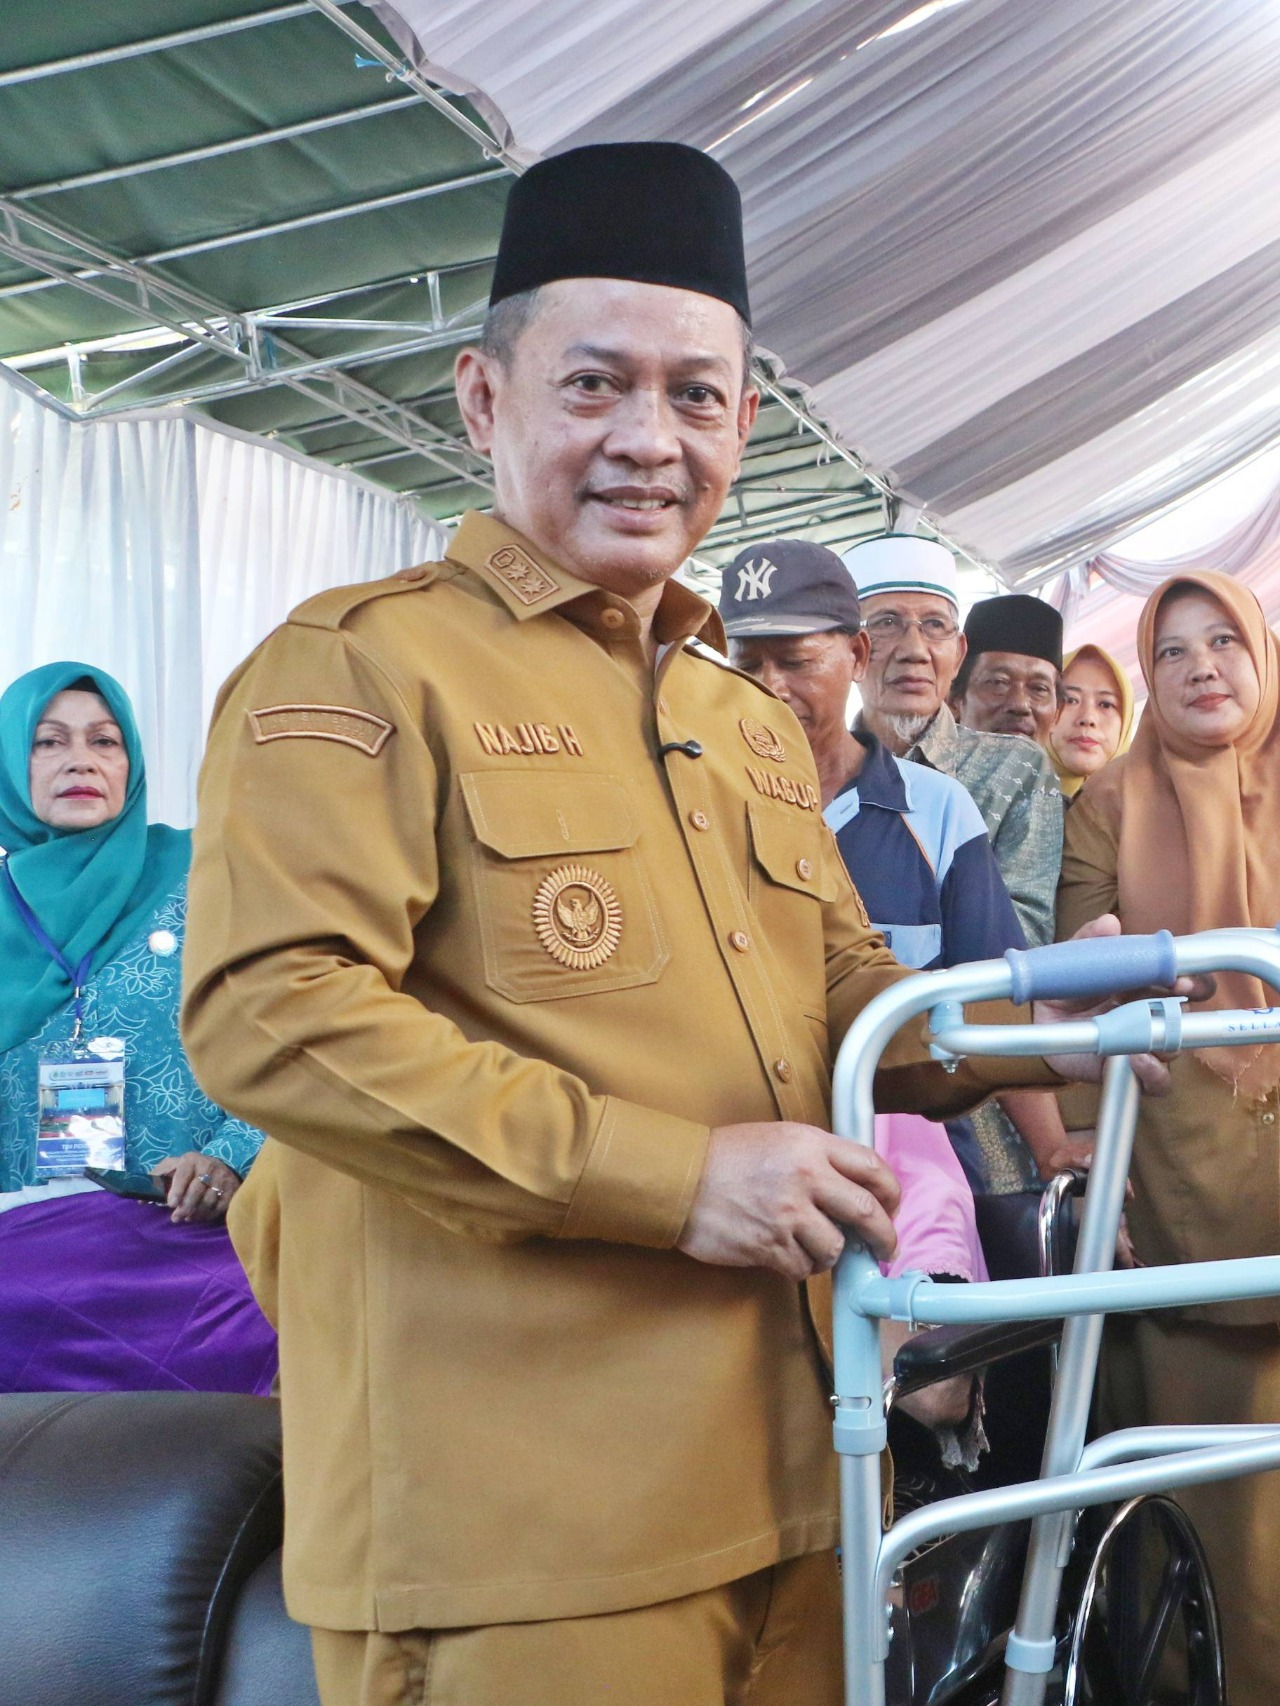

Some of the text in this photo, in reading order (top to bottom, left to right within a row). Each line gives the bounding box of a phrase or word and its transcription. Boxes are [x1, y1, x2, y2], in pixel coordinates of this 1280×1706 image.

[474, 722, 583, 756] NAJIB H
[745, 766, 818, 812] WABUP
